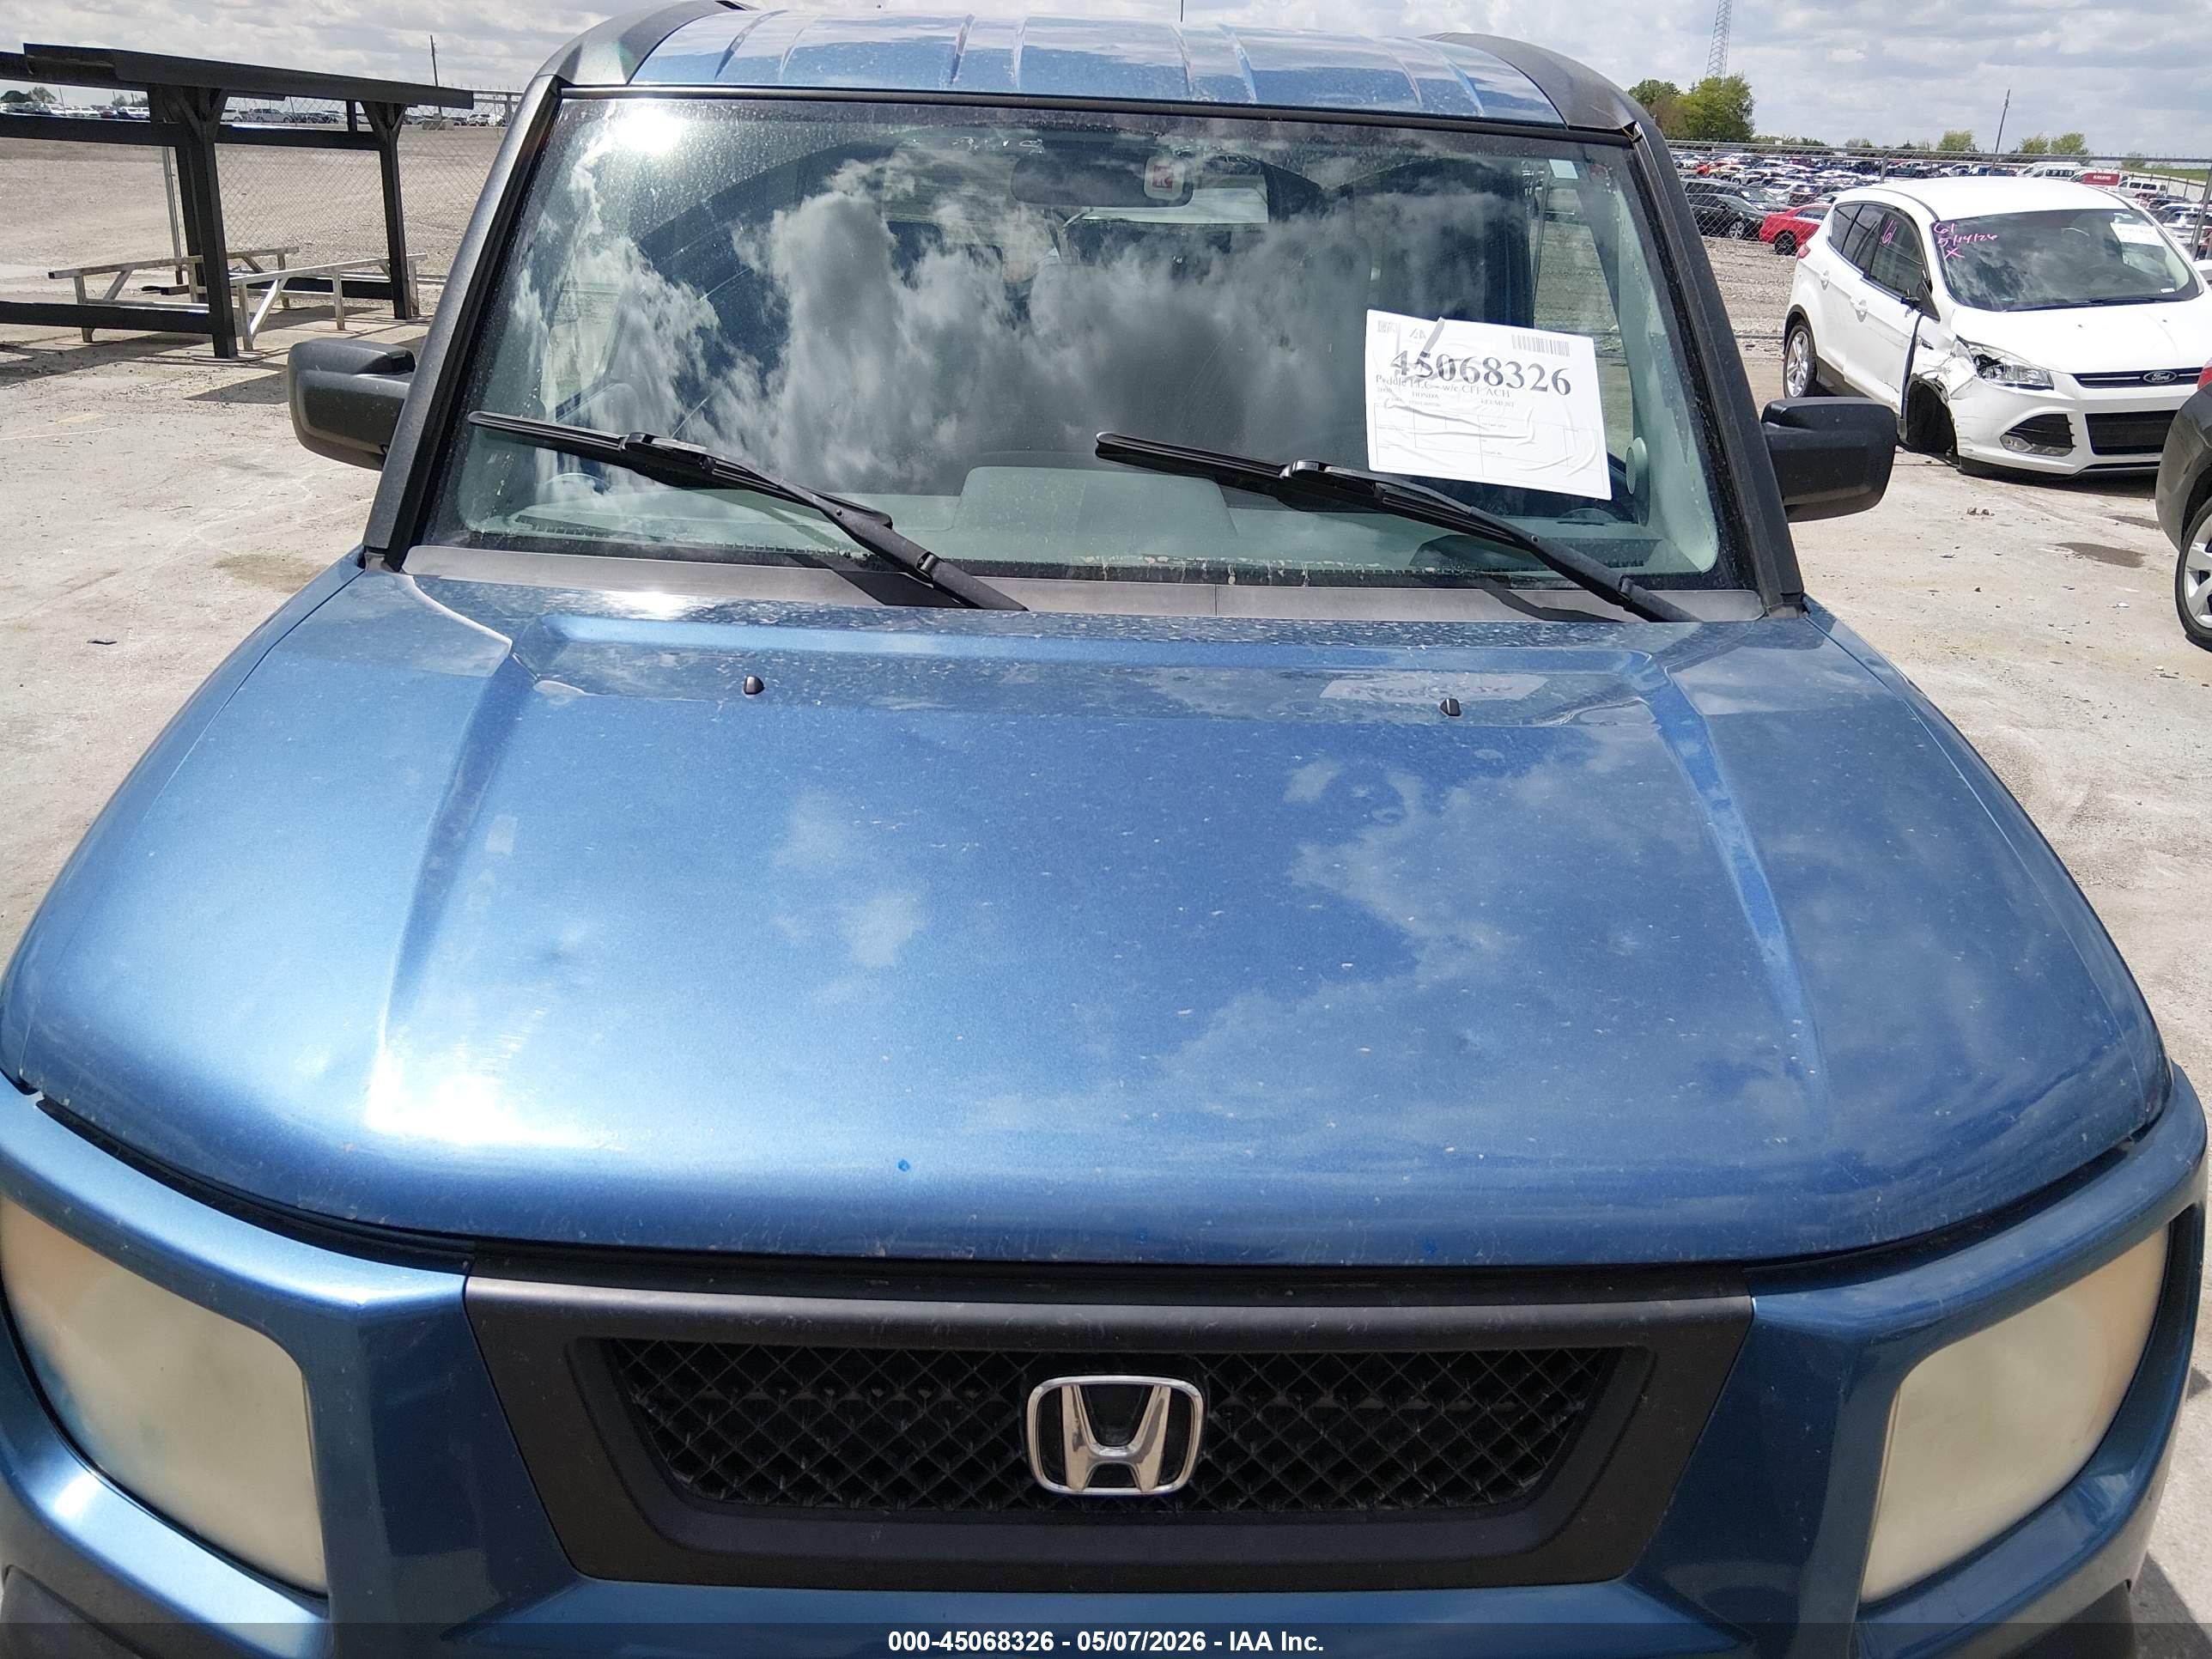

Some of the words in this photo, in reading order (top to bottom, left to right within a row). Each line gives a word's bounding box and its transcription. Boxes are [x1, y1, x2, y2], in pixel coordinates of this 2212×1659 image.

[1934, 222, 1955, 234] 61
[1389, 350, 1571, 396] 45068326
[2151, 372, 2171, 381] Ford
